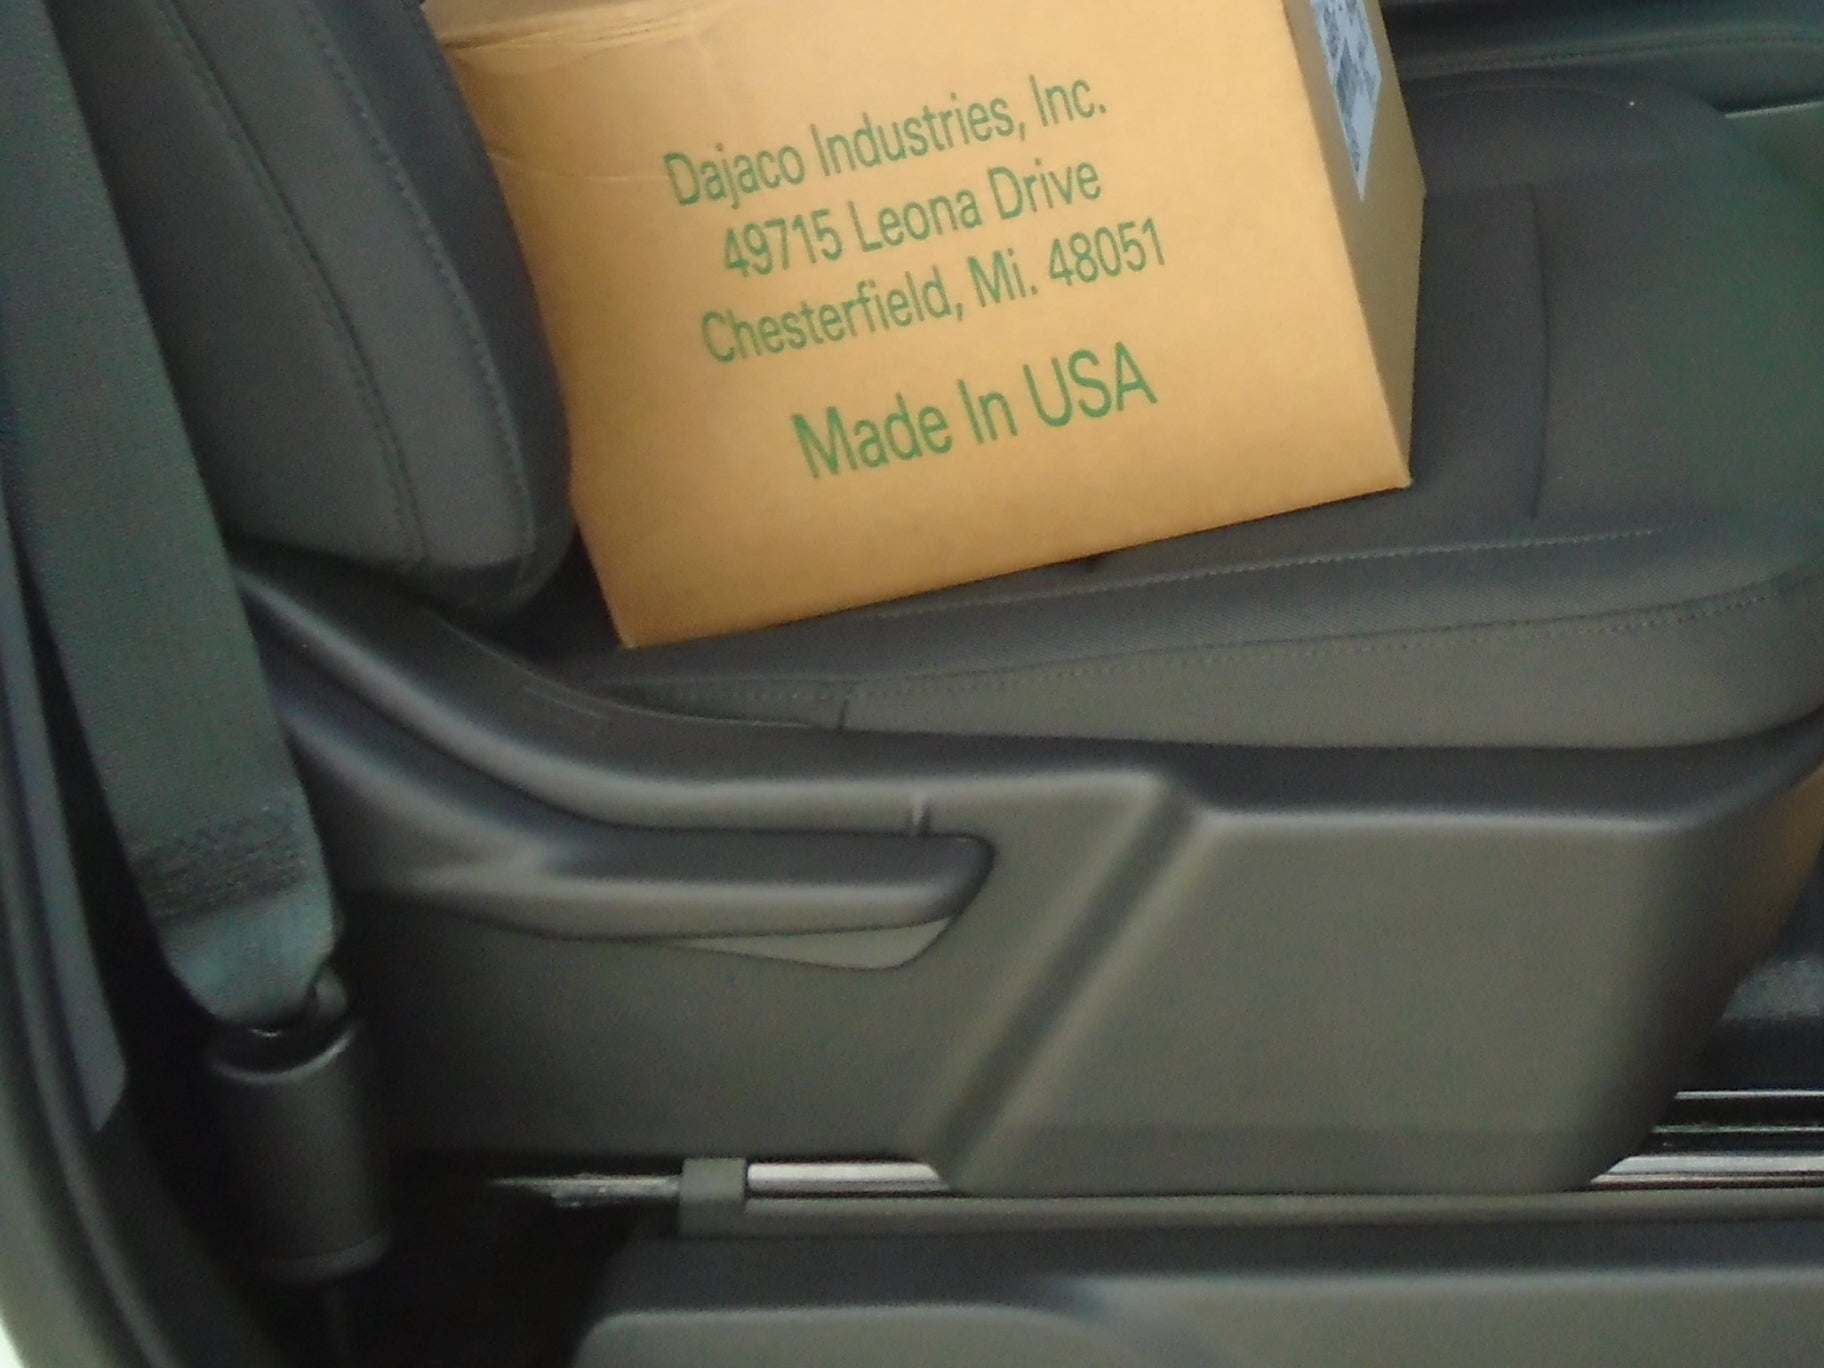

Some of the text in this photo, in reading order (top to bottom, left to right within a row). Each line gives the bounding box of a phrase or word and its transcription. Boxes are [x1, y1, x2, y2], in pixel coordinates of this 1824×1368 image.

[663, 74, 1107, 209] Dajaco Industries, Inc.
[722, 157, 1102, 278] 49715 Leona Drive
[701, 218, 1165, 364] Chesterfield, Mi. 48051
[791, 340, 1158, 479] Made In USA
